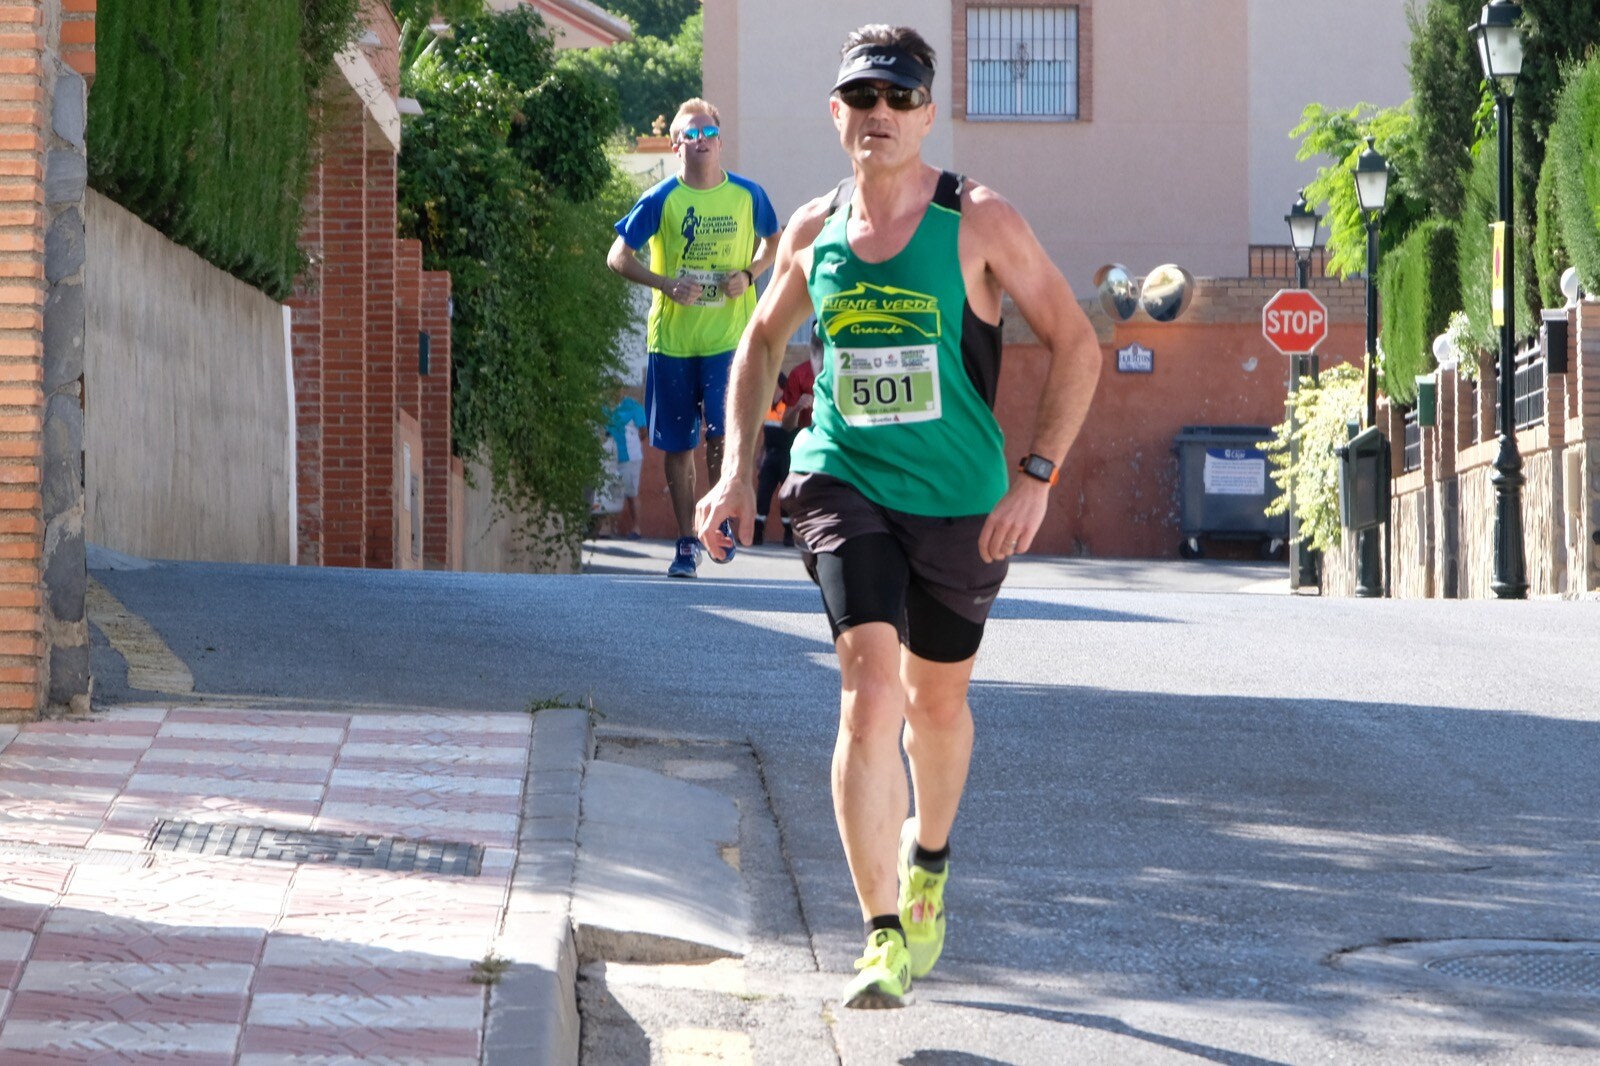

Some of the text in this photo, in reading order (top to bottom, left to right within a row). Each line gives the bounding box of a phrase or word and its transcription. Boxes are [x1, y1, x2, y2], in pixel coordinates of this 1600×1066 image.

[882, 299, 938, 310] VERDE
[850, 323, 904, 335] Granada
[1267, 309, 1324, 335] STOP
[853, 375, 913, 406] 501
